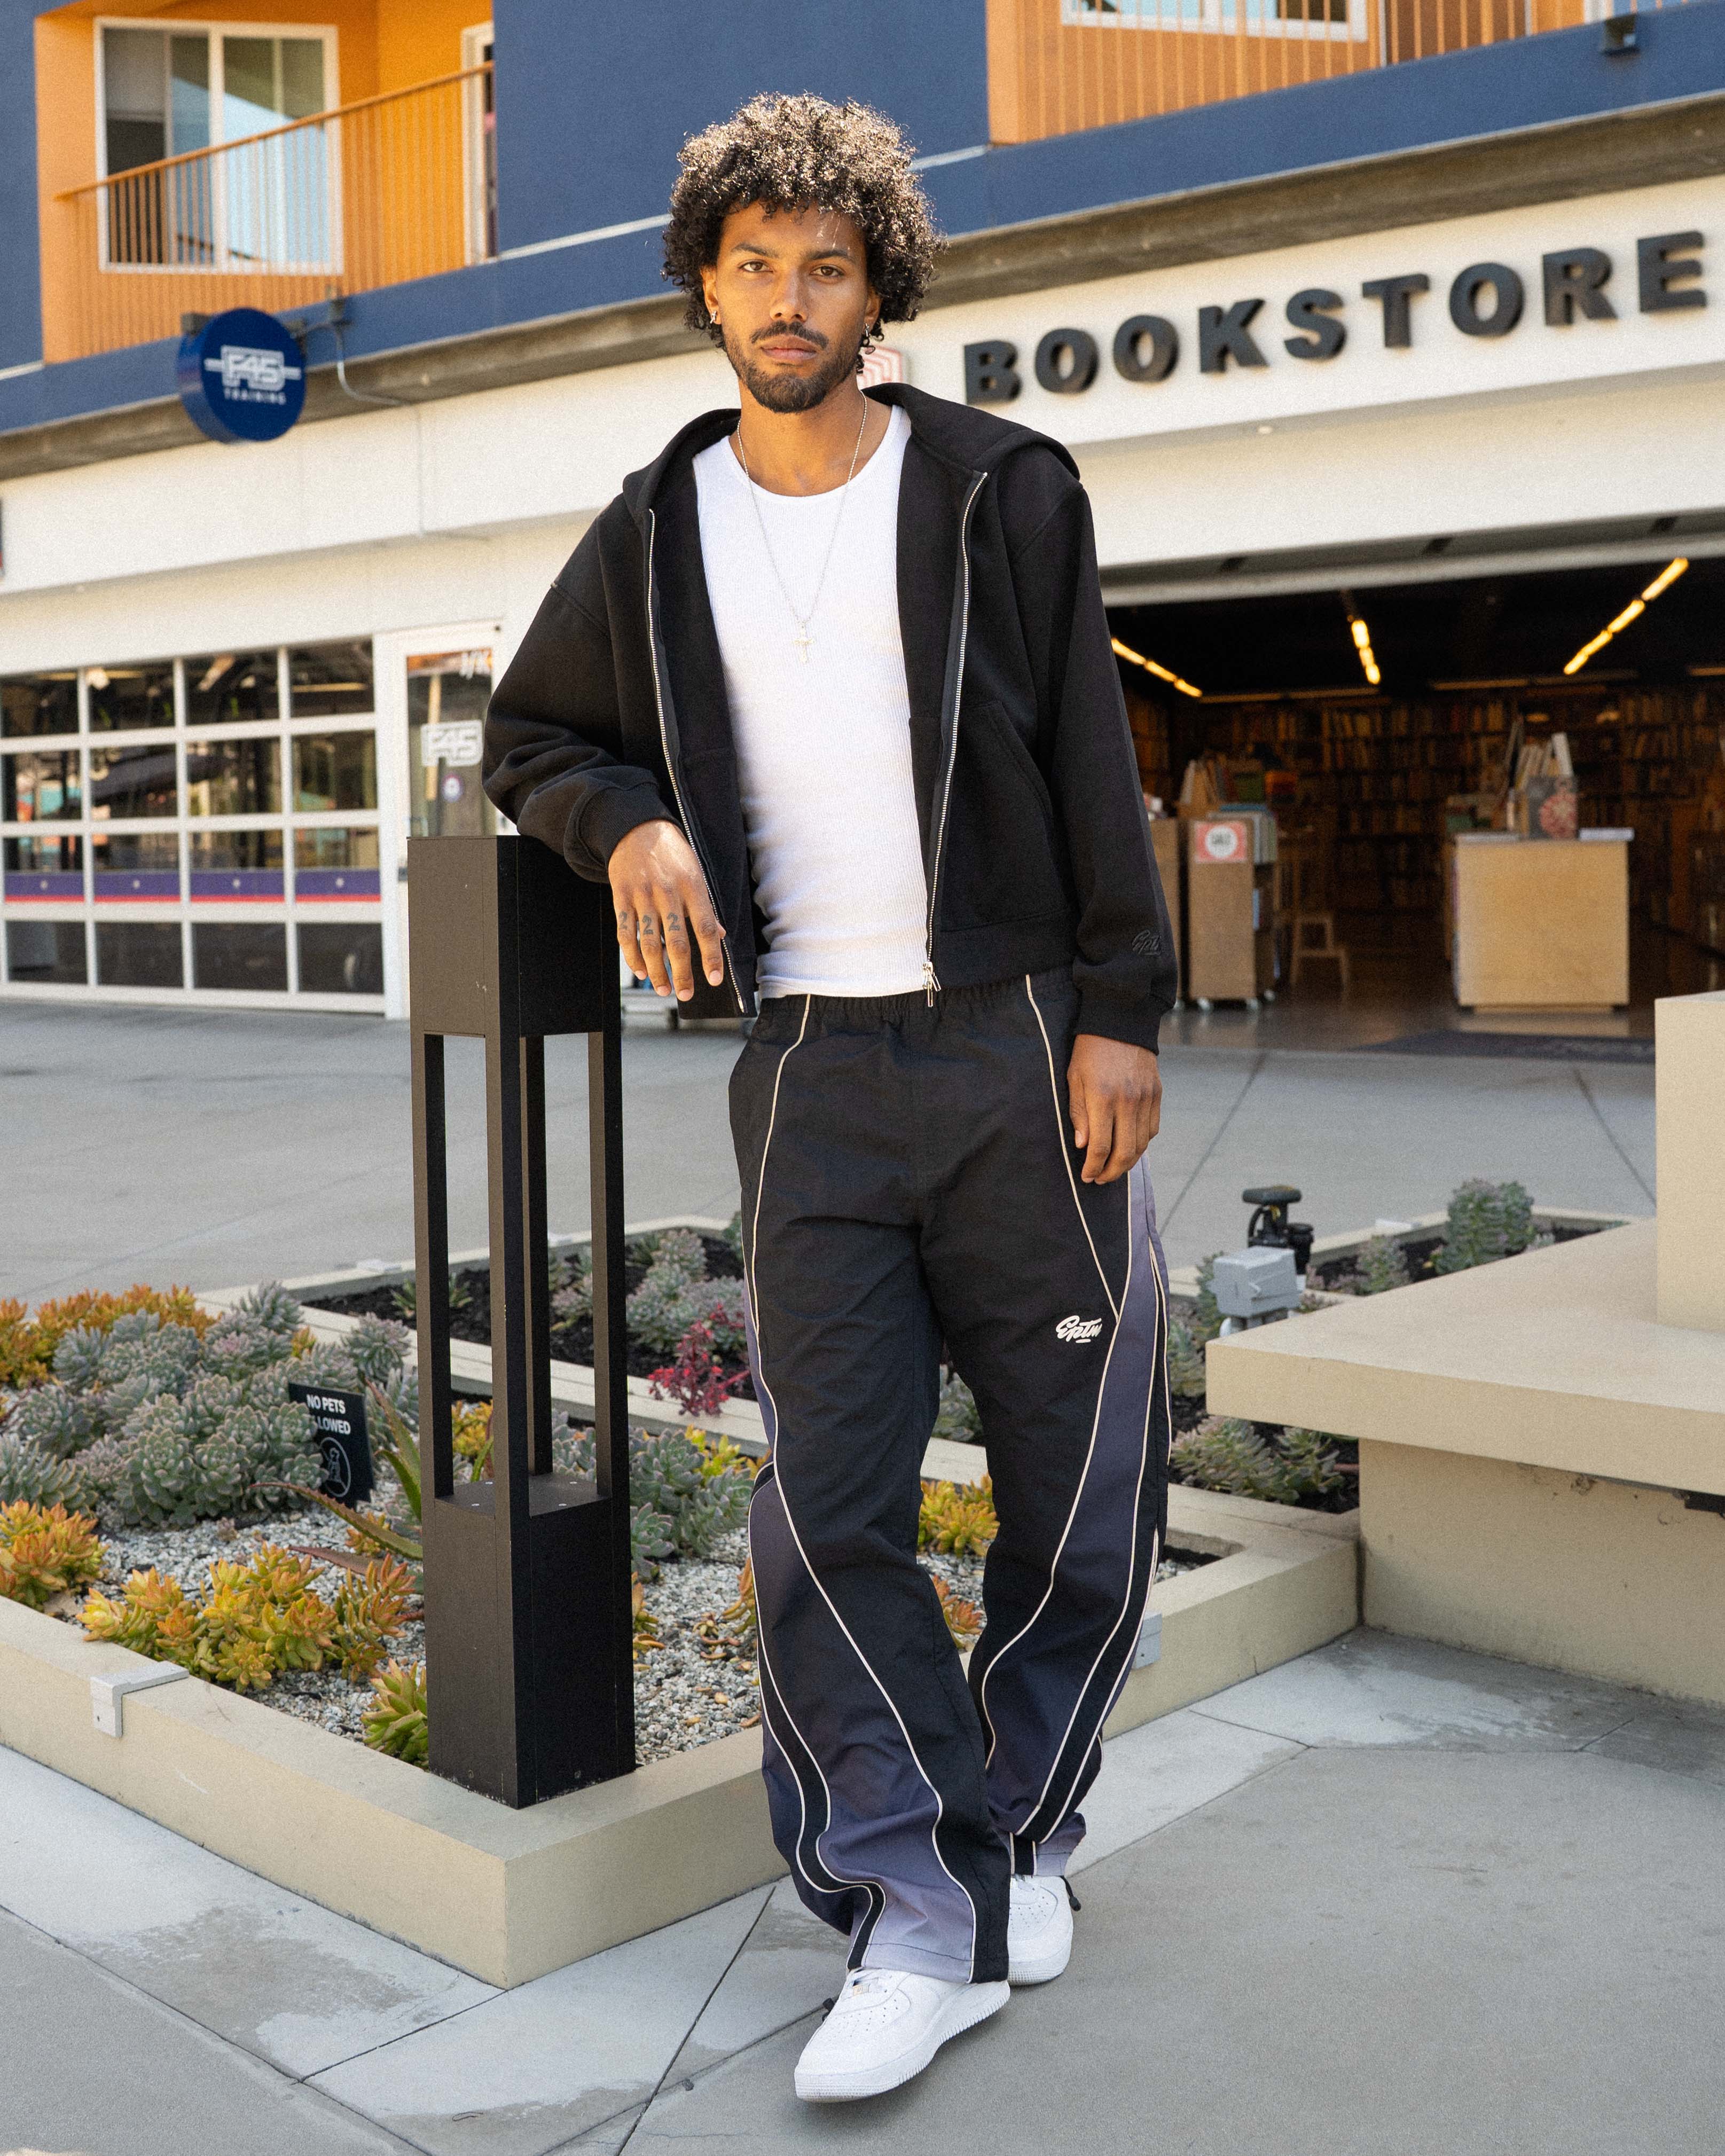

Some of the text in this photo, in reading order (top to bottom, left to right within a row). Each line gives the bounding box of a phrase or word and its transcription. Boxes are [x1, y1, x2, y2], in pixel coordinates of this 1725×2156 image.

[963, 230, 1708, 406] BOOKSTORE
[307, 1394, 346, 1414] NO PETS
[317, 1415, 351, 1435] LOWED
